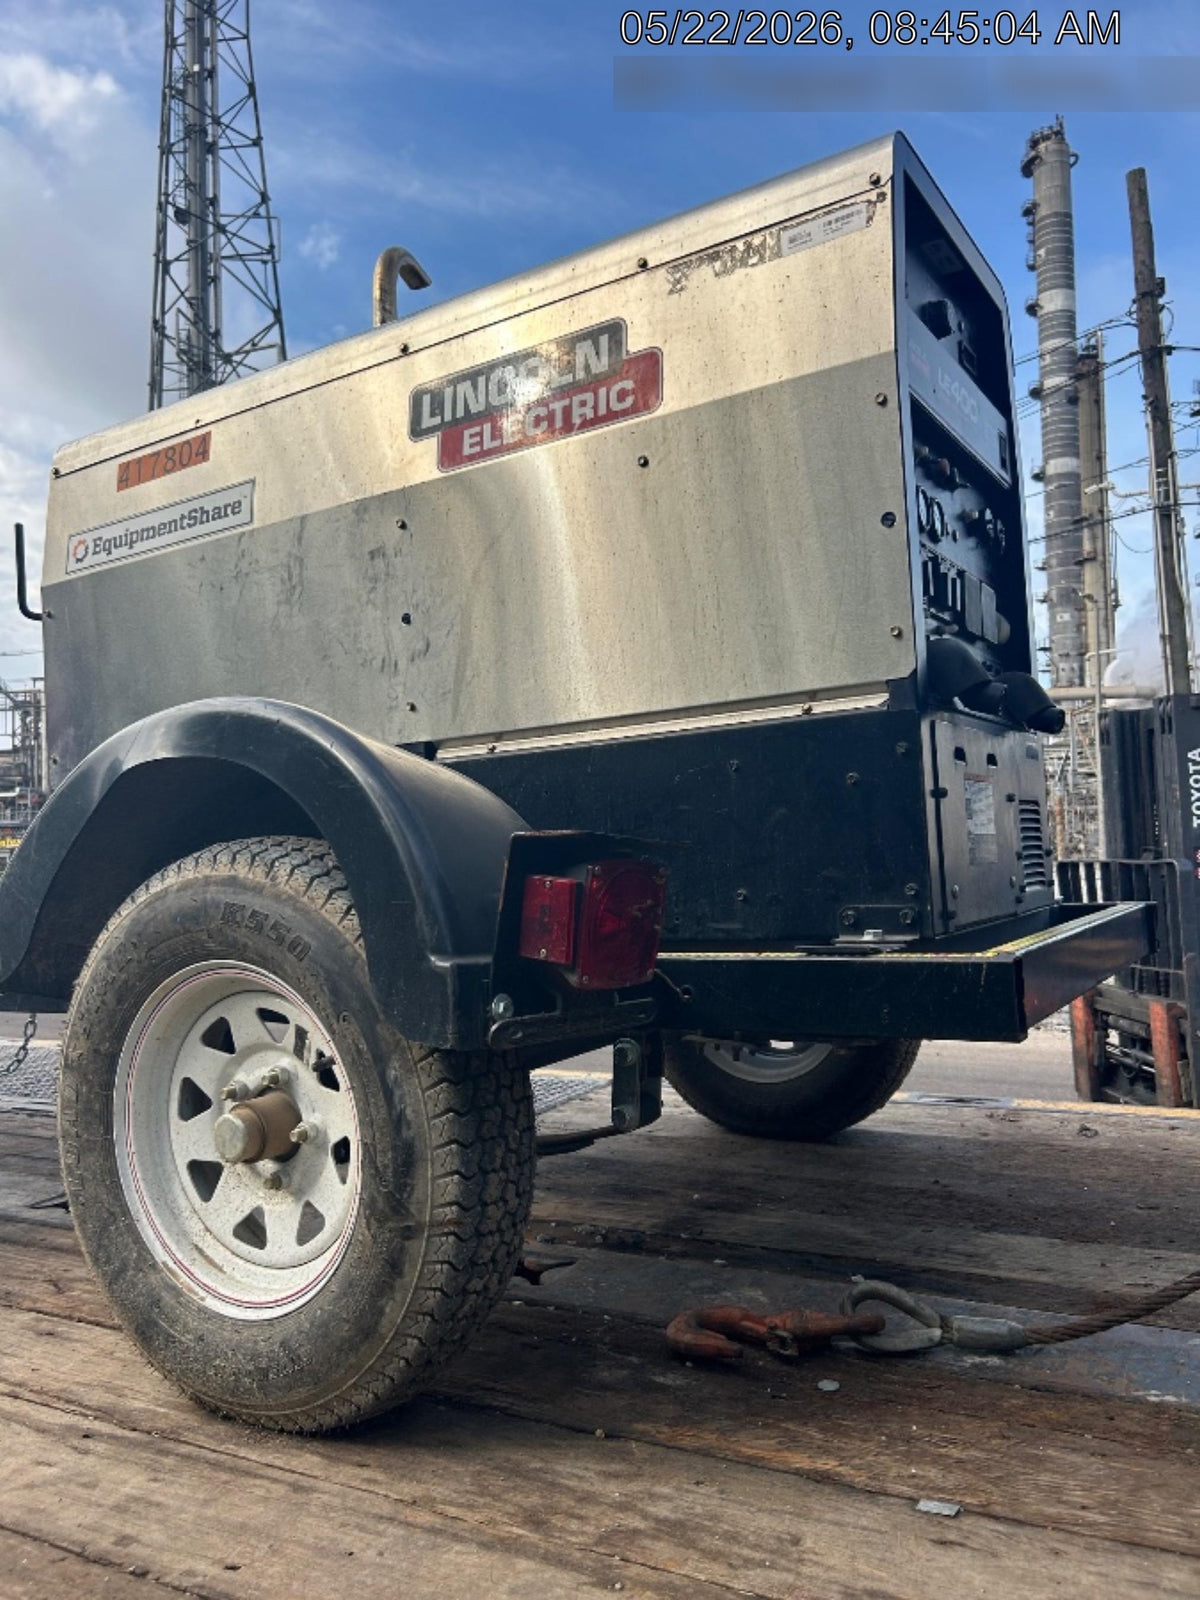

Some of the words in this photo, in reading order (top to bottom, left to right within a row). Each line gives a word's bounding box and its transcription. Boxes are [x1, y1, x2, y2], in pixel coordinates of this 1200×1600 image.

[462, 379, 636, 456] ELECTRIC
[118, 435, 208, 489] 417804
[91, 499, 243, 556] EquipmentShare
